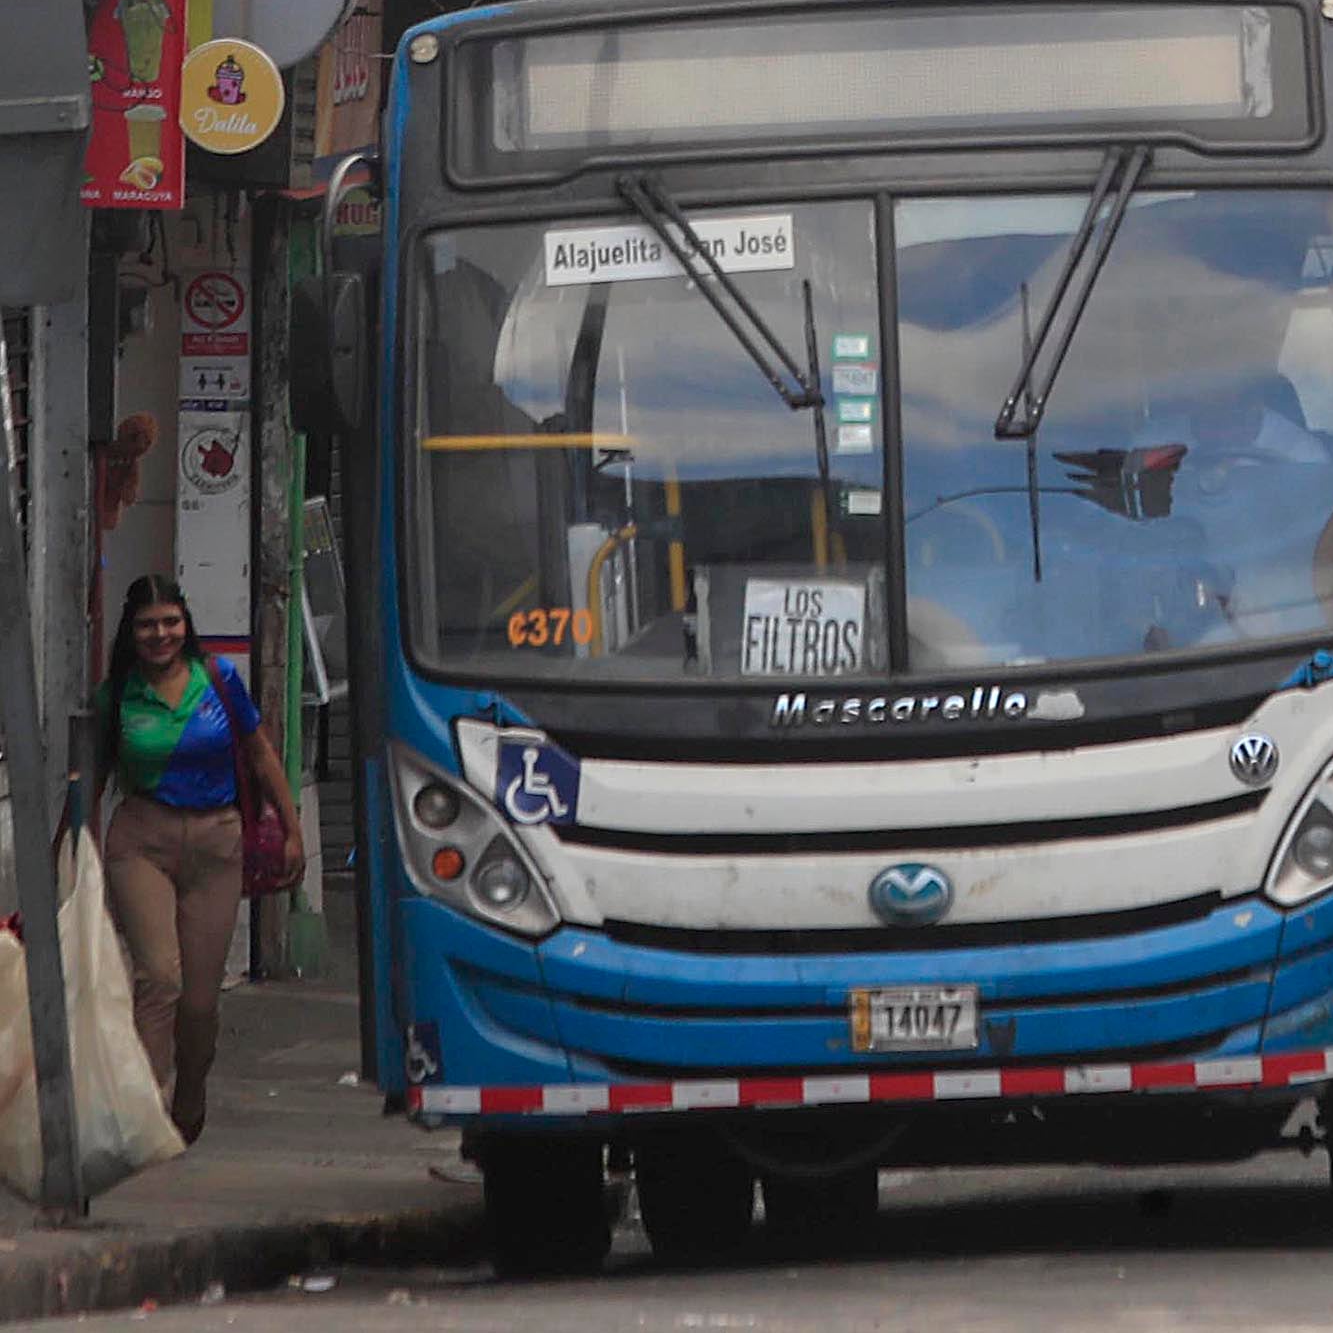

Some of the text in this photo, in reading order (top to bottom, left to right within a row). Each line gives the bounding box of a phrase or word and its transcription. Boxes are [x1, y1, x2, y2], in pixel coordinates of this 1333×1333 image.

[553, 239, 662, 272] Alajuelita
[733, 227, 788, 257] José
[785, 586, 824, 618] LOS
[745, 615, 859, 673] FILTROS
[769, 684, 1027, 726] Mascarello
[884, 1003, 962, 1041] 14047
